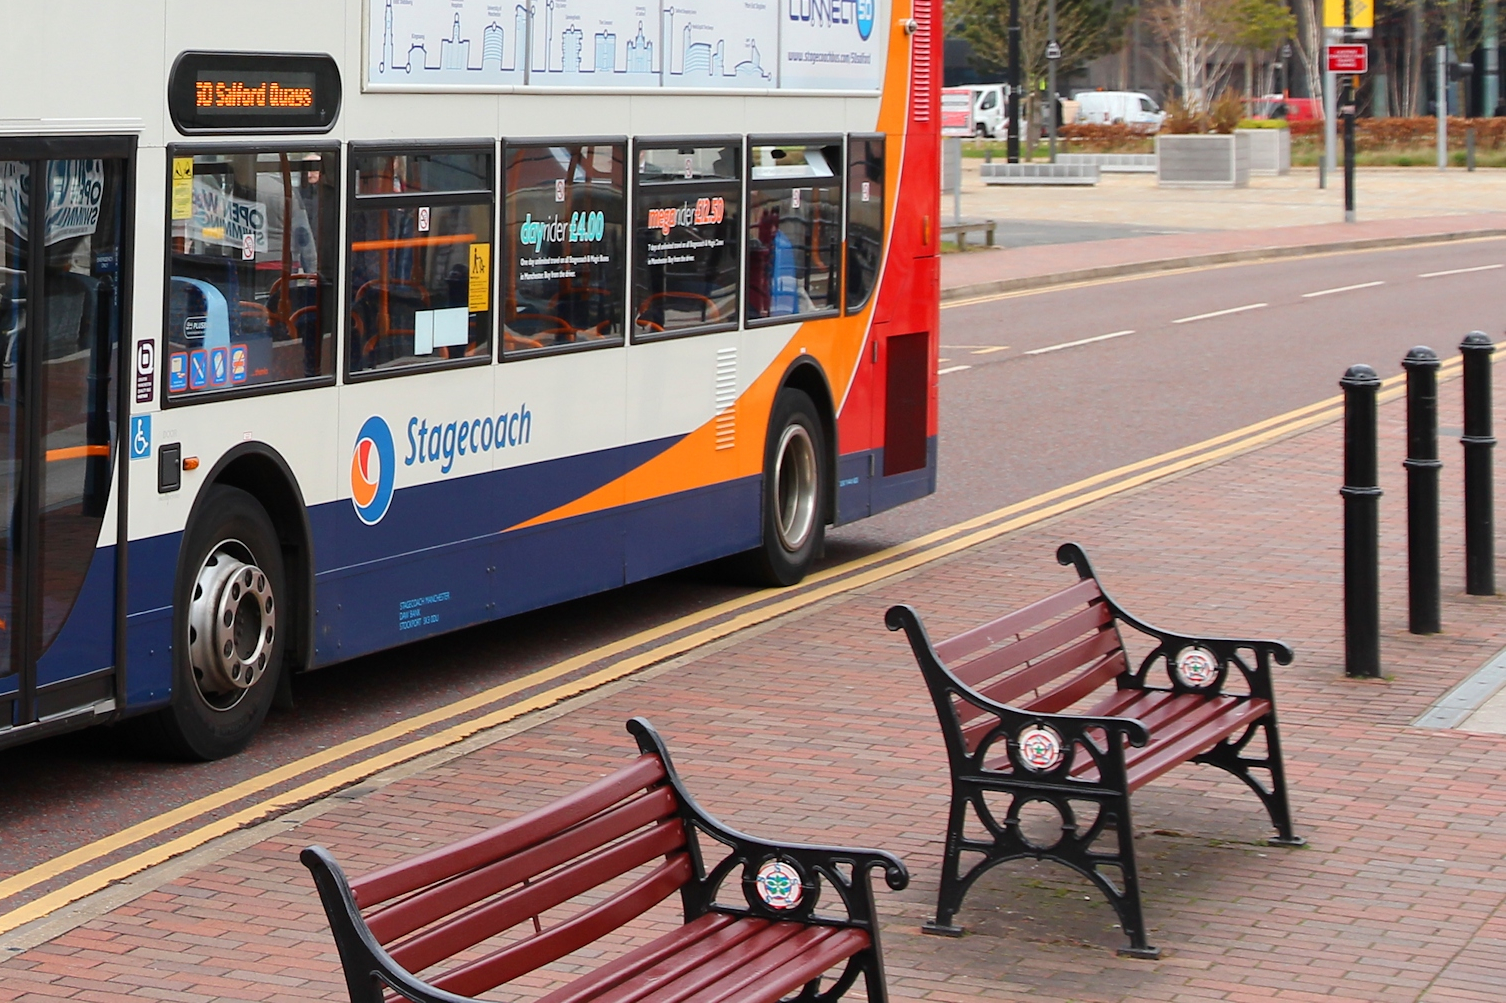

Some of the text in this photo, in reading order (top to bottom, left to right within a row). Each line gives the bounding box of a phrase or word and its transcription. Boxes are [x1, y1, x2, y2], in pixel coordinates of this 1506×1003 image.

[216, 82, 266, 107] Salford
[270, 82, 312, 107] Quays
[520, 210, 605, 253] dayrider £4.00
[404, 403, 532, 474] Stagecoach
